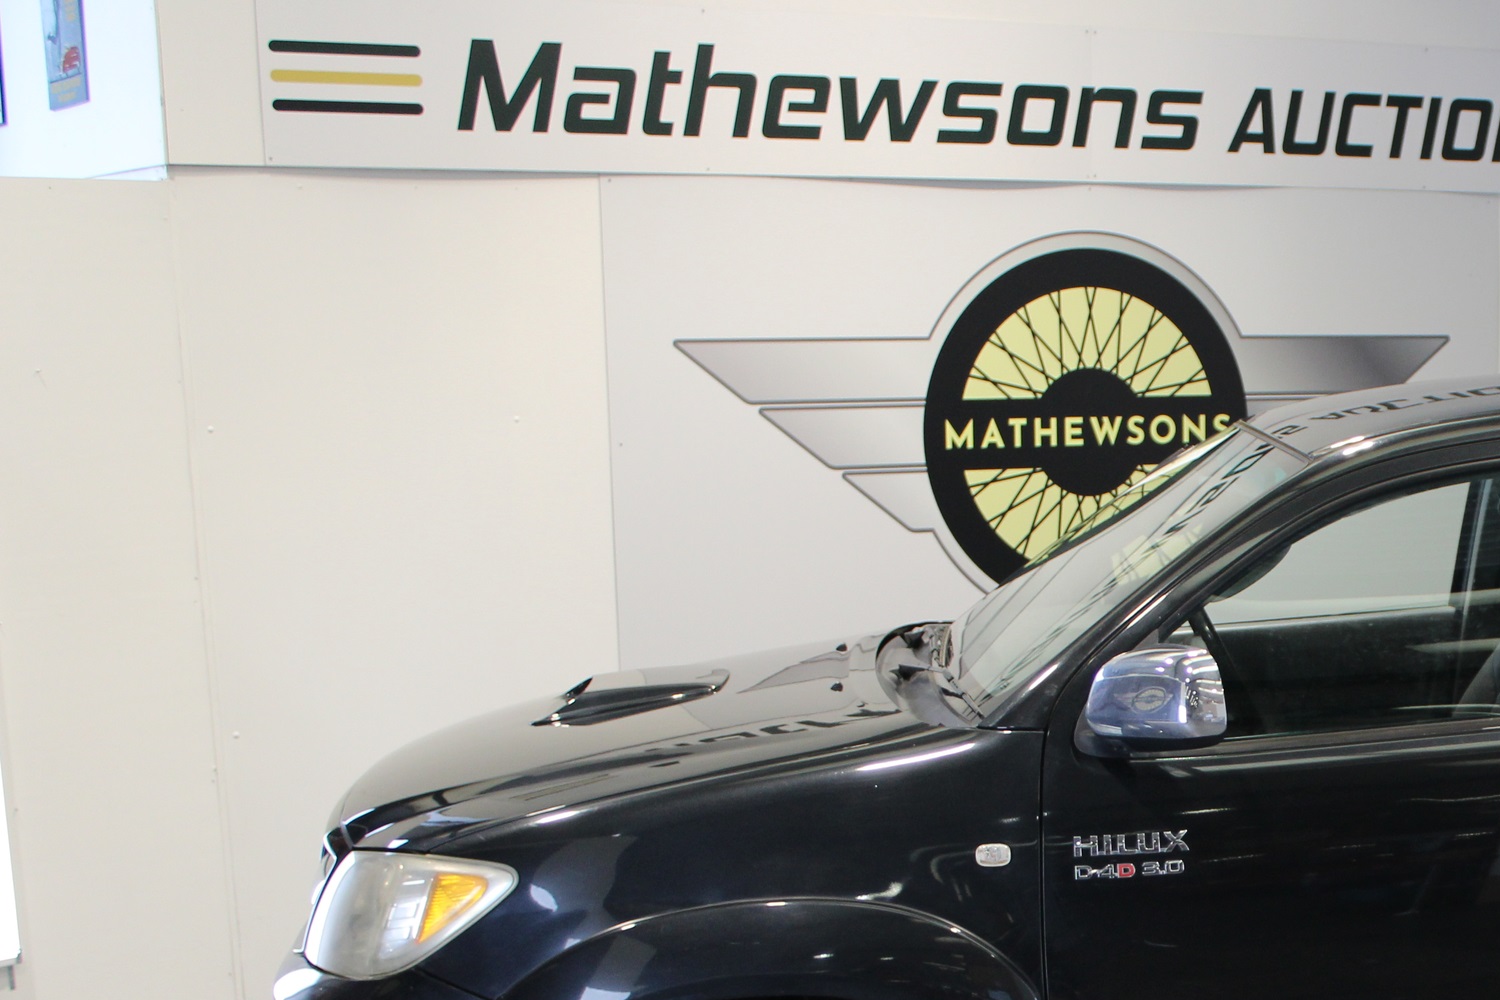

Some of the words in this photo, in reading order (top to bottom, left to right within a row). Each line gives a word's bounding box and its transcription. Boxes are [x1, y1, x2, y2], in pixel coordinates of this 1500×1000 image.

[458, 40, 1202, 151] Mathewsons
[1073, 829, 1190, 858] HILUX
[1075, 863, 1136, 880] D-4D
[1142, 860, 1185, 876] 3.0
